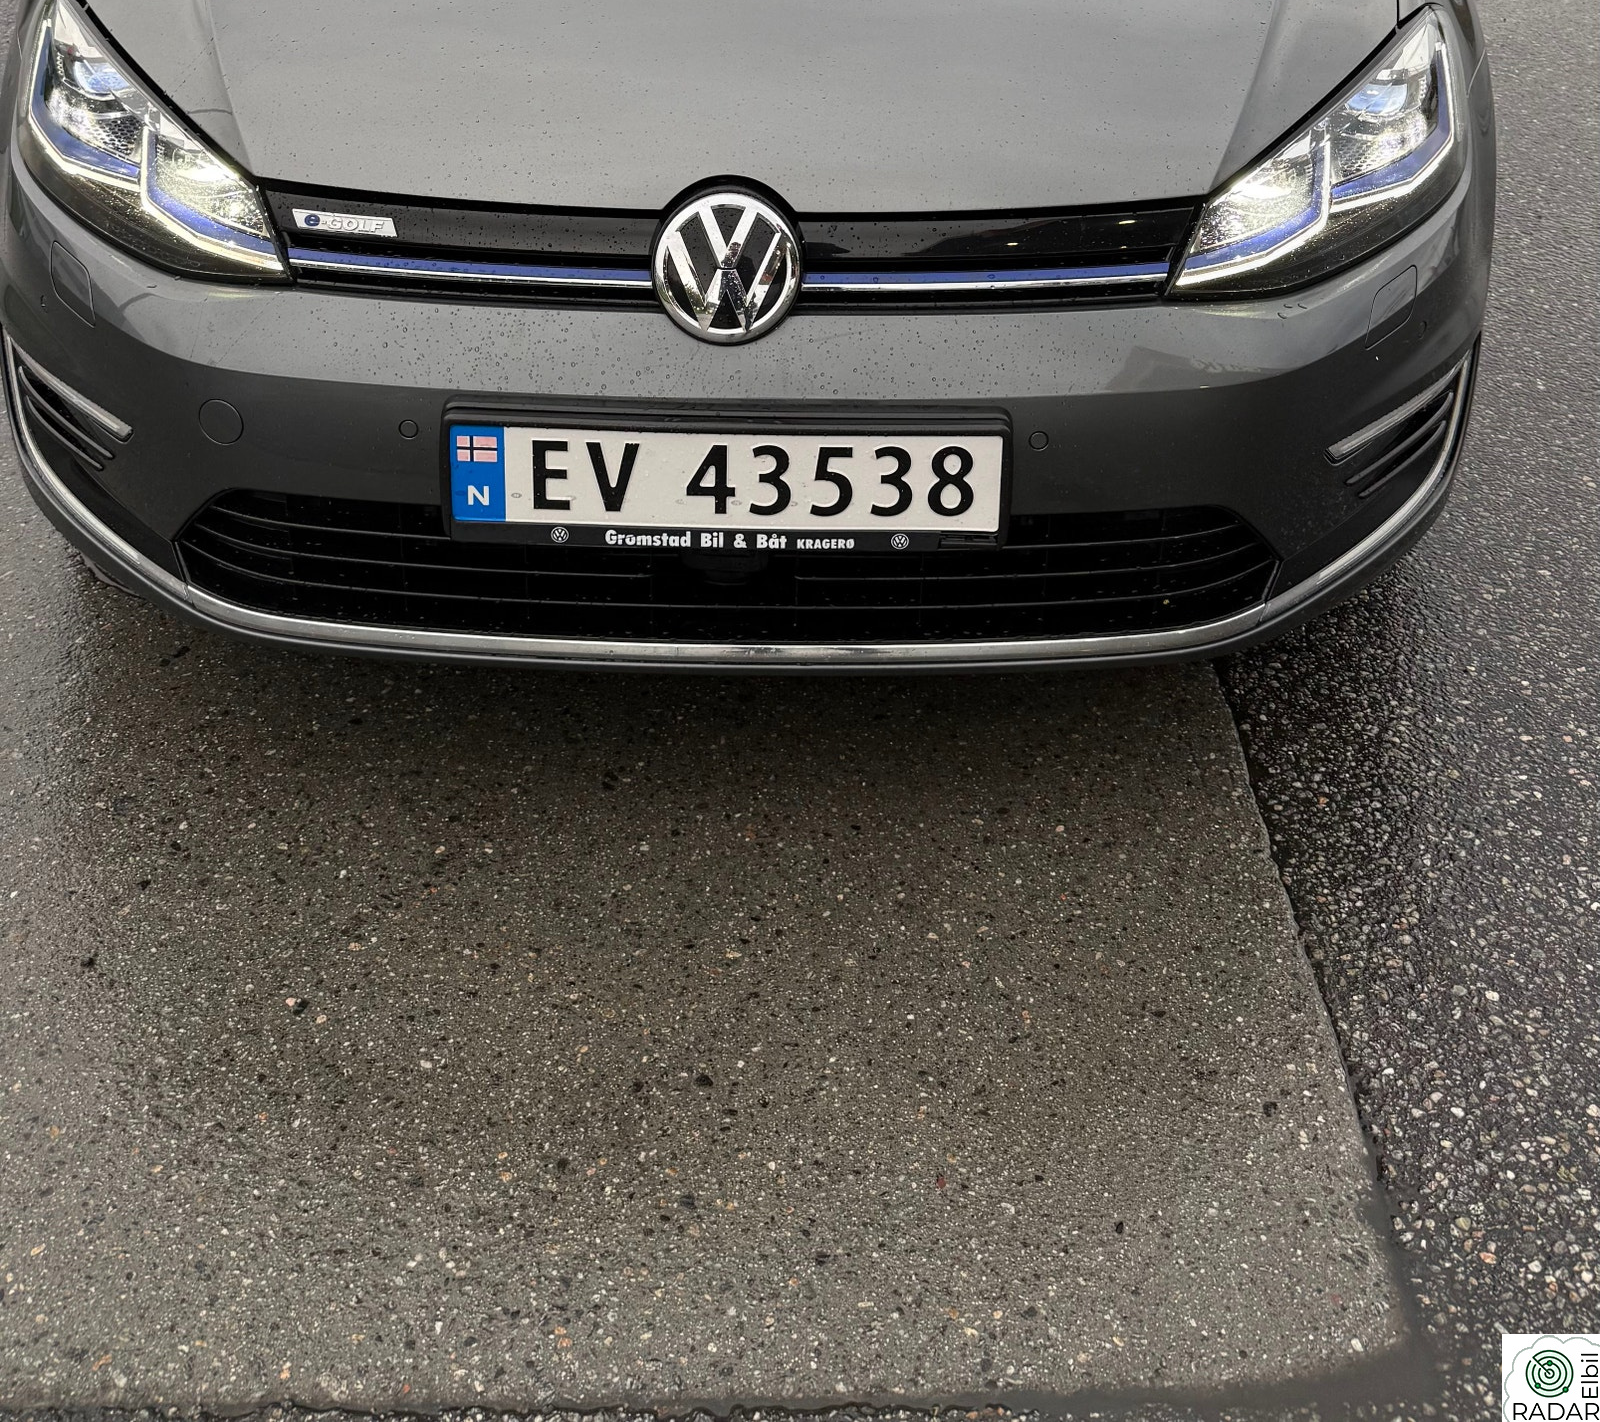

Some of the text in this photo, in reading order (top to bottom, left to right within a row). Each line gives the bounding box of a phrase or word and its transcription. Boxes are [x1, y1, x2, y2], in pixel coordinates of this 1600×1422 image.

[532, 439, 974, 517] EV 43538
[467, 485, 490, 506] N
[701, 531, 724, 548] Bil
[733, 533, 748, 549] &
[756, 533, 788, 549] Båt
[796, 538, 855, 550] KRAGERØ
